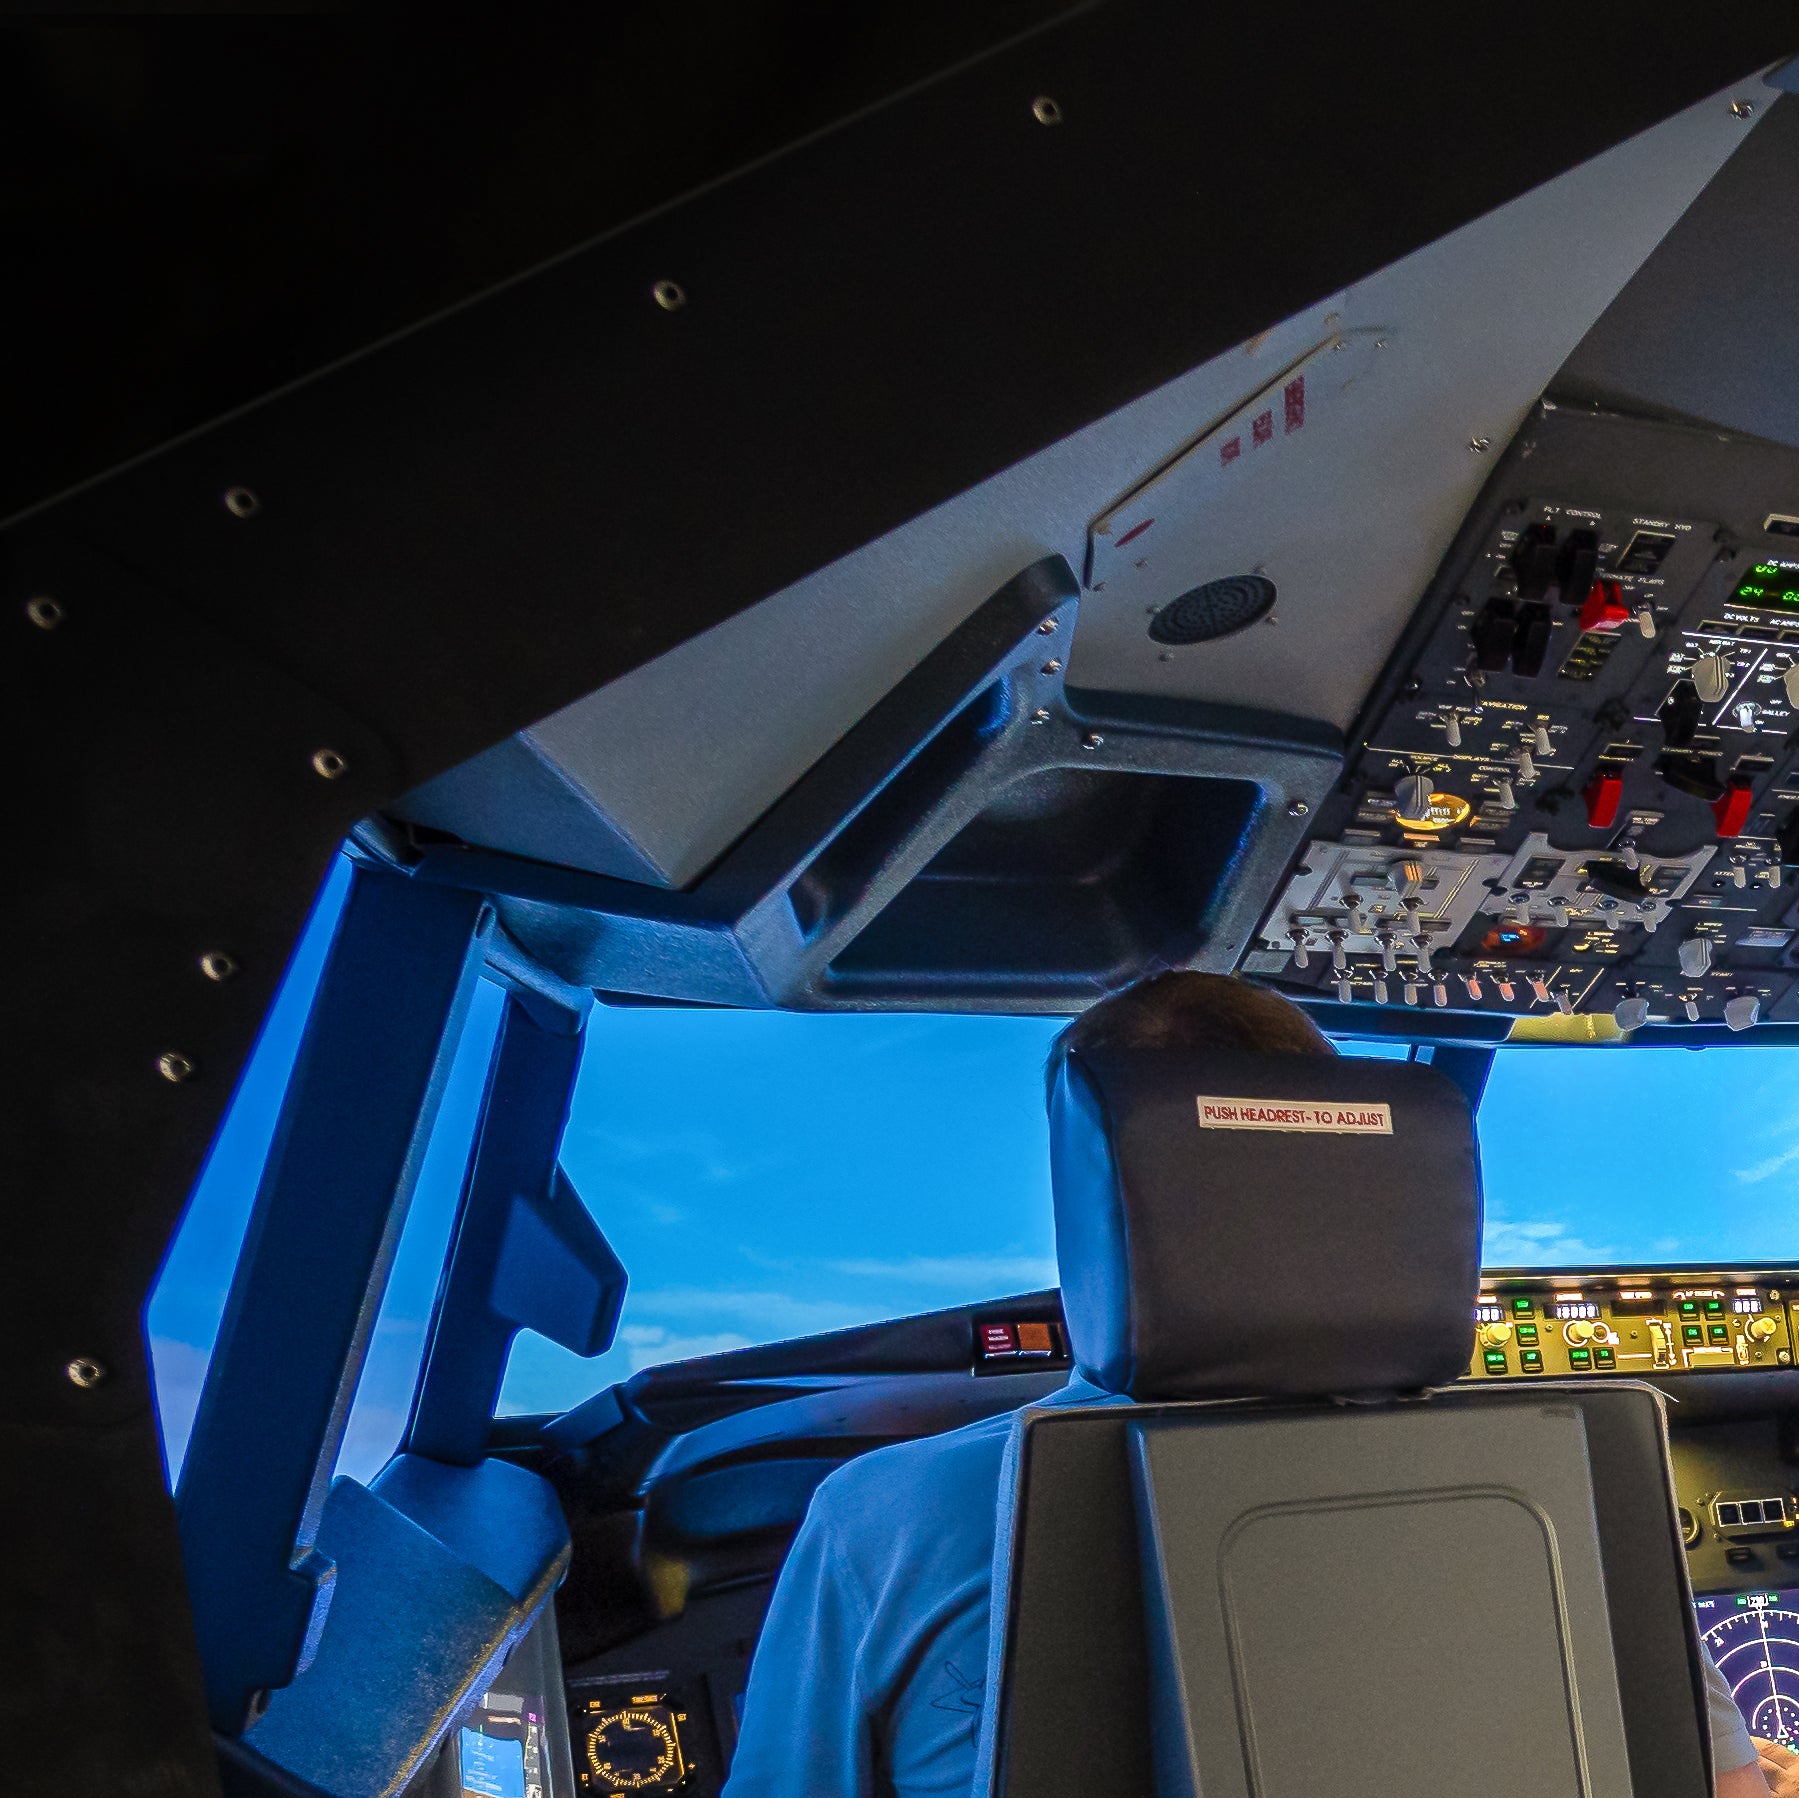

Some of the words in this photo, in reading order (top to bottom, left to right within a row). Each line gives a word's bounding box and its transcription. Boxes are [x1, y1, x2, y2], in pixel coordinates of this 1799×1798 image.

[1481, 700, 1528, 711] AVIGATION
[1204, 1105, 1238, 1120] PUSH
[1314, 1110, 1333, 1125] TO
[1336, 1111, 1385, 1127] ADJUST
